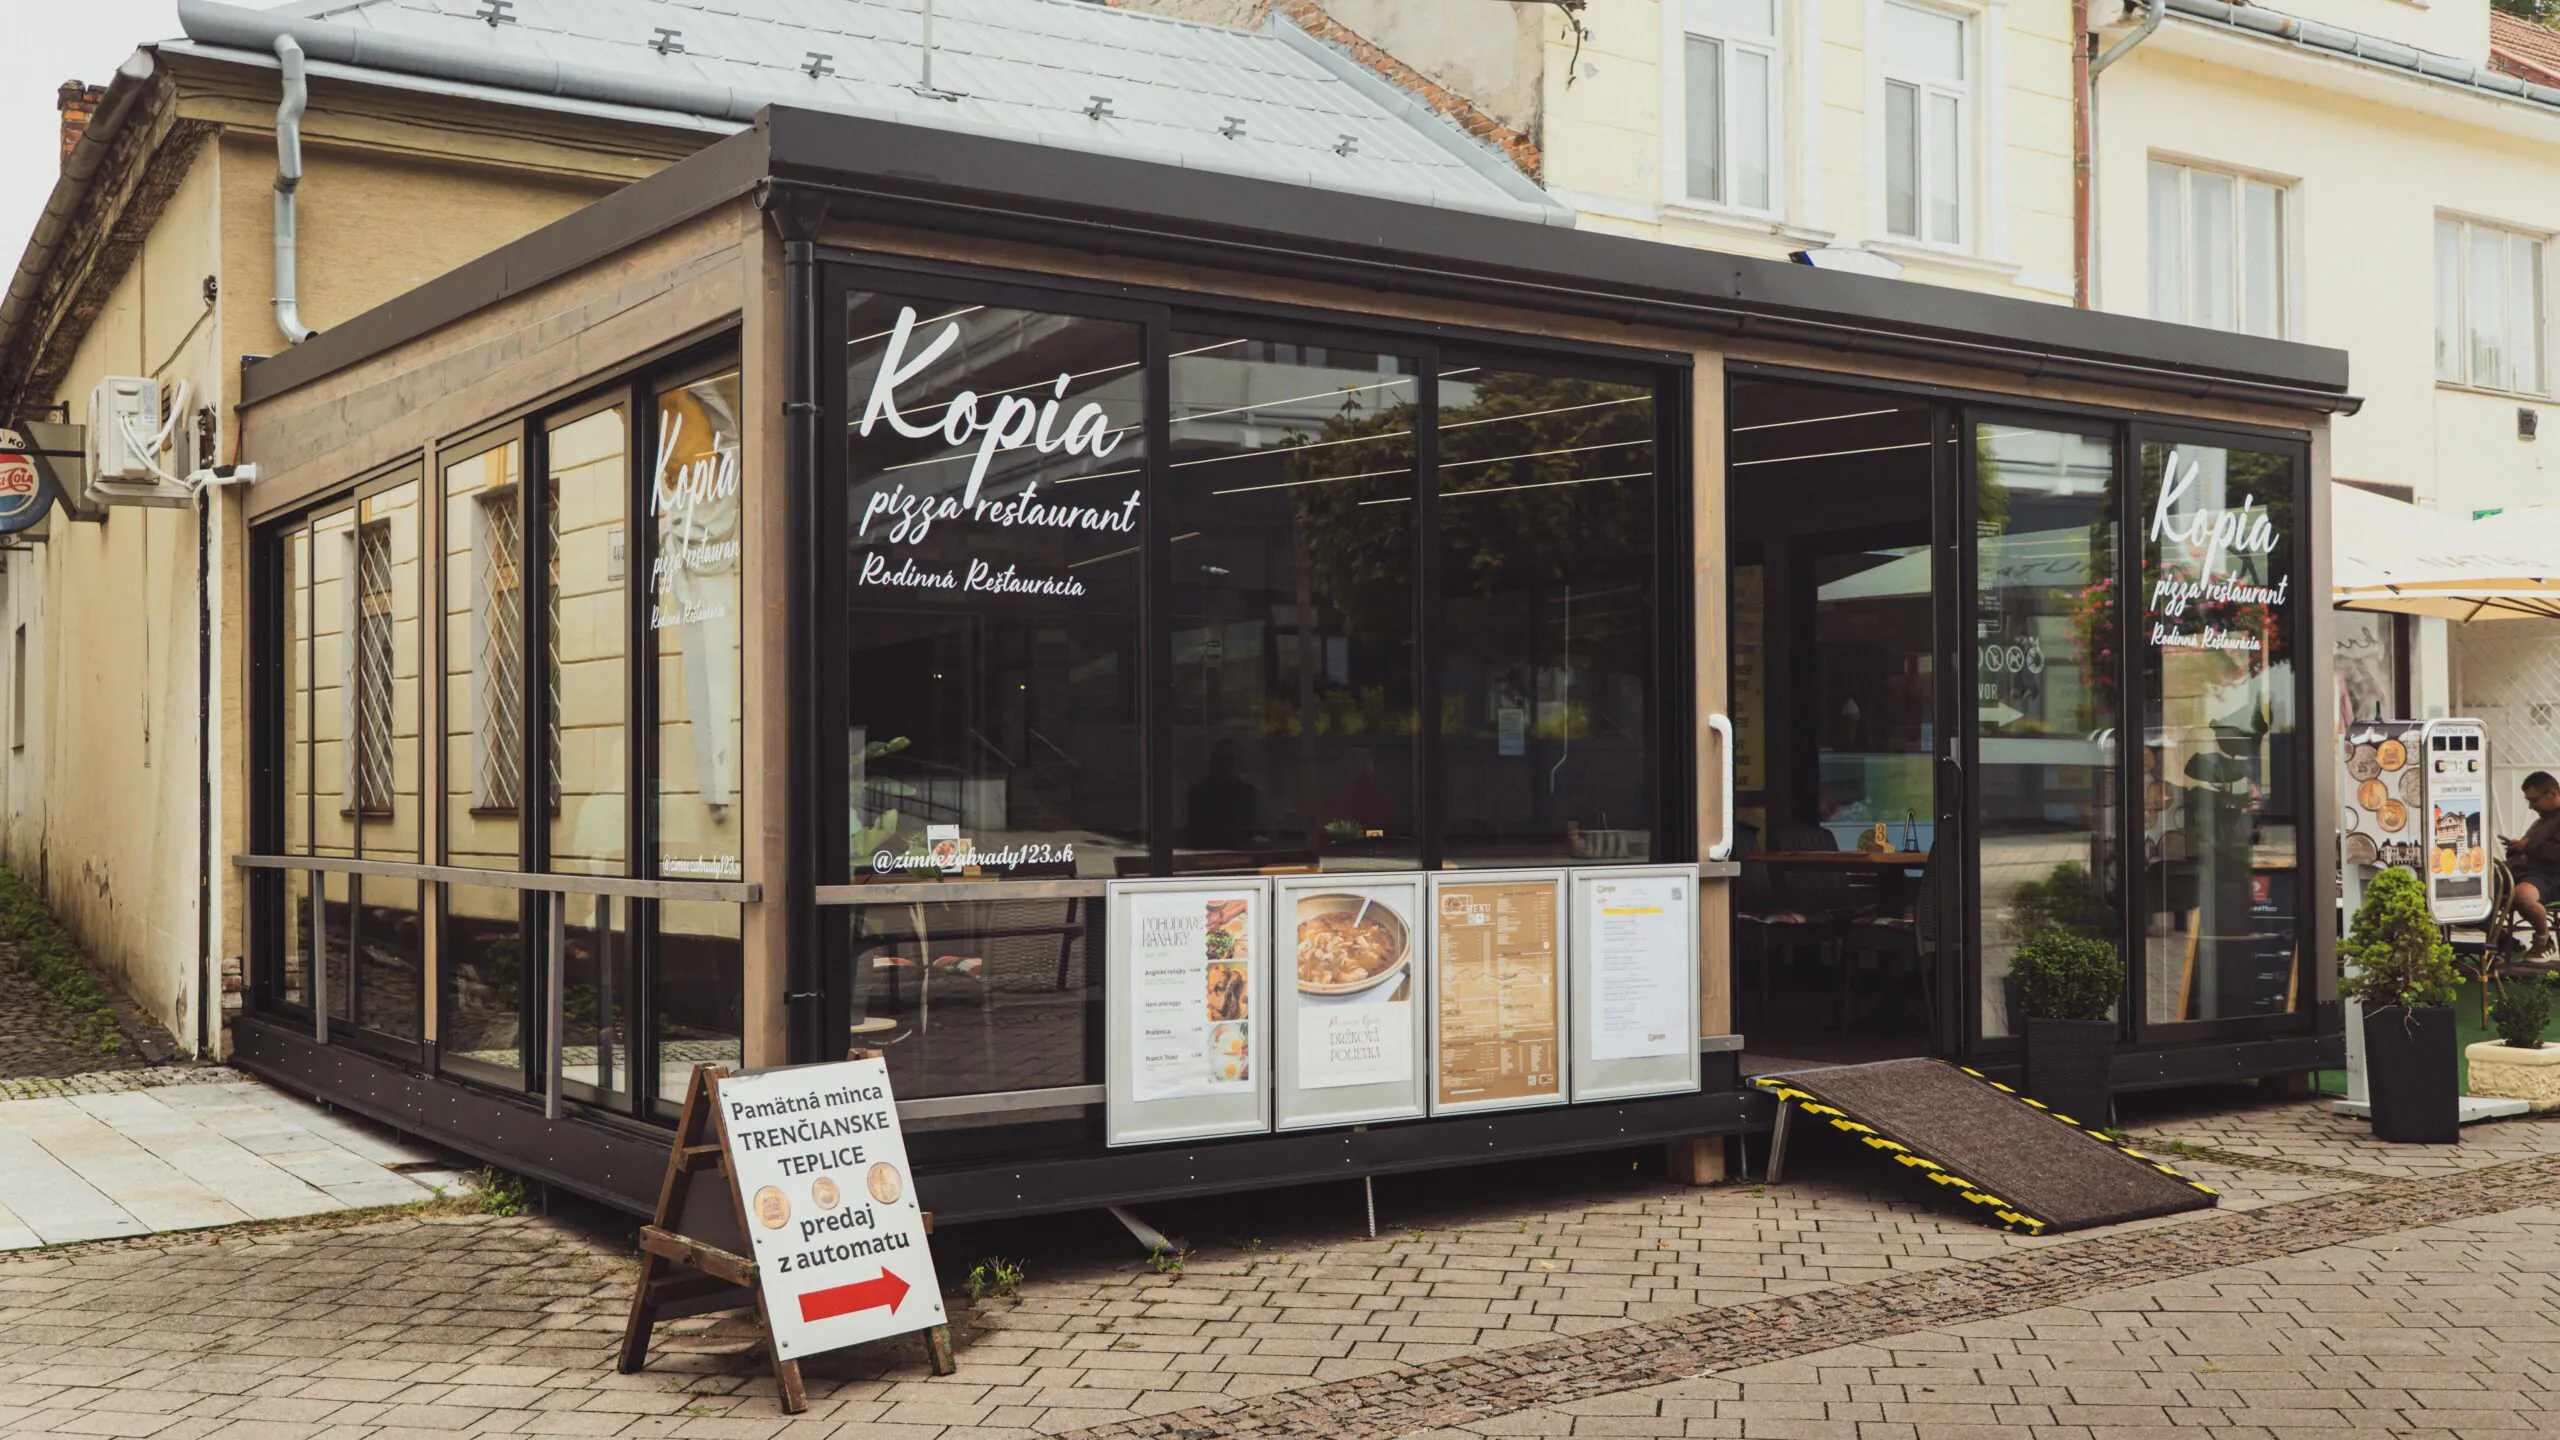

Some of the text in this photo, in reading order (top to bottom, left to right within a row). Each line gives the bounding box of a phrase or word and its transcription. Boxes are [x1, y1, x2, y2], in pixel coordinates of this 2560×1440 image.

[860, 306, 1123, 509] Kopia
[651, 409, 740, 557] Kopia
[859, 481, 1141, 545] pizza restaurant
[2151, 450, 2280, 591] Kopia
[686, 528, 740, 568] restauran
[859, 552, 1086, 596] Rodinná Reštaurácia
[2150, 570, 2288, 616] pizza restaurant
[1978, 683, 1998, 700] VOR
[873, 843, 1075, 874] @zimnezahrady123.sk
[731, 1085, 884, 1121] Pamätná minca
[738, 1111, 890, 1151] TRENČIANSKE
[777, 1145, 867, 1177] TEPLICE
[799, 1202, 876, 1242] predaj
[778, 1231, 910, 1273] z automatu
